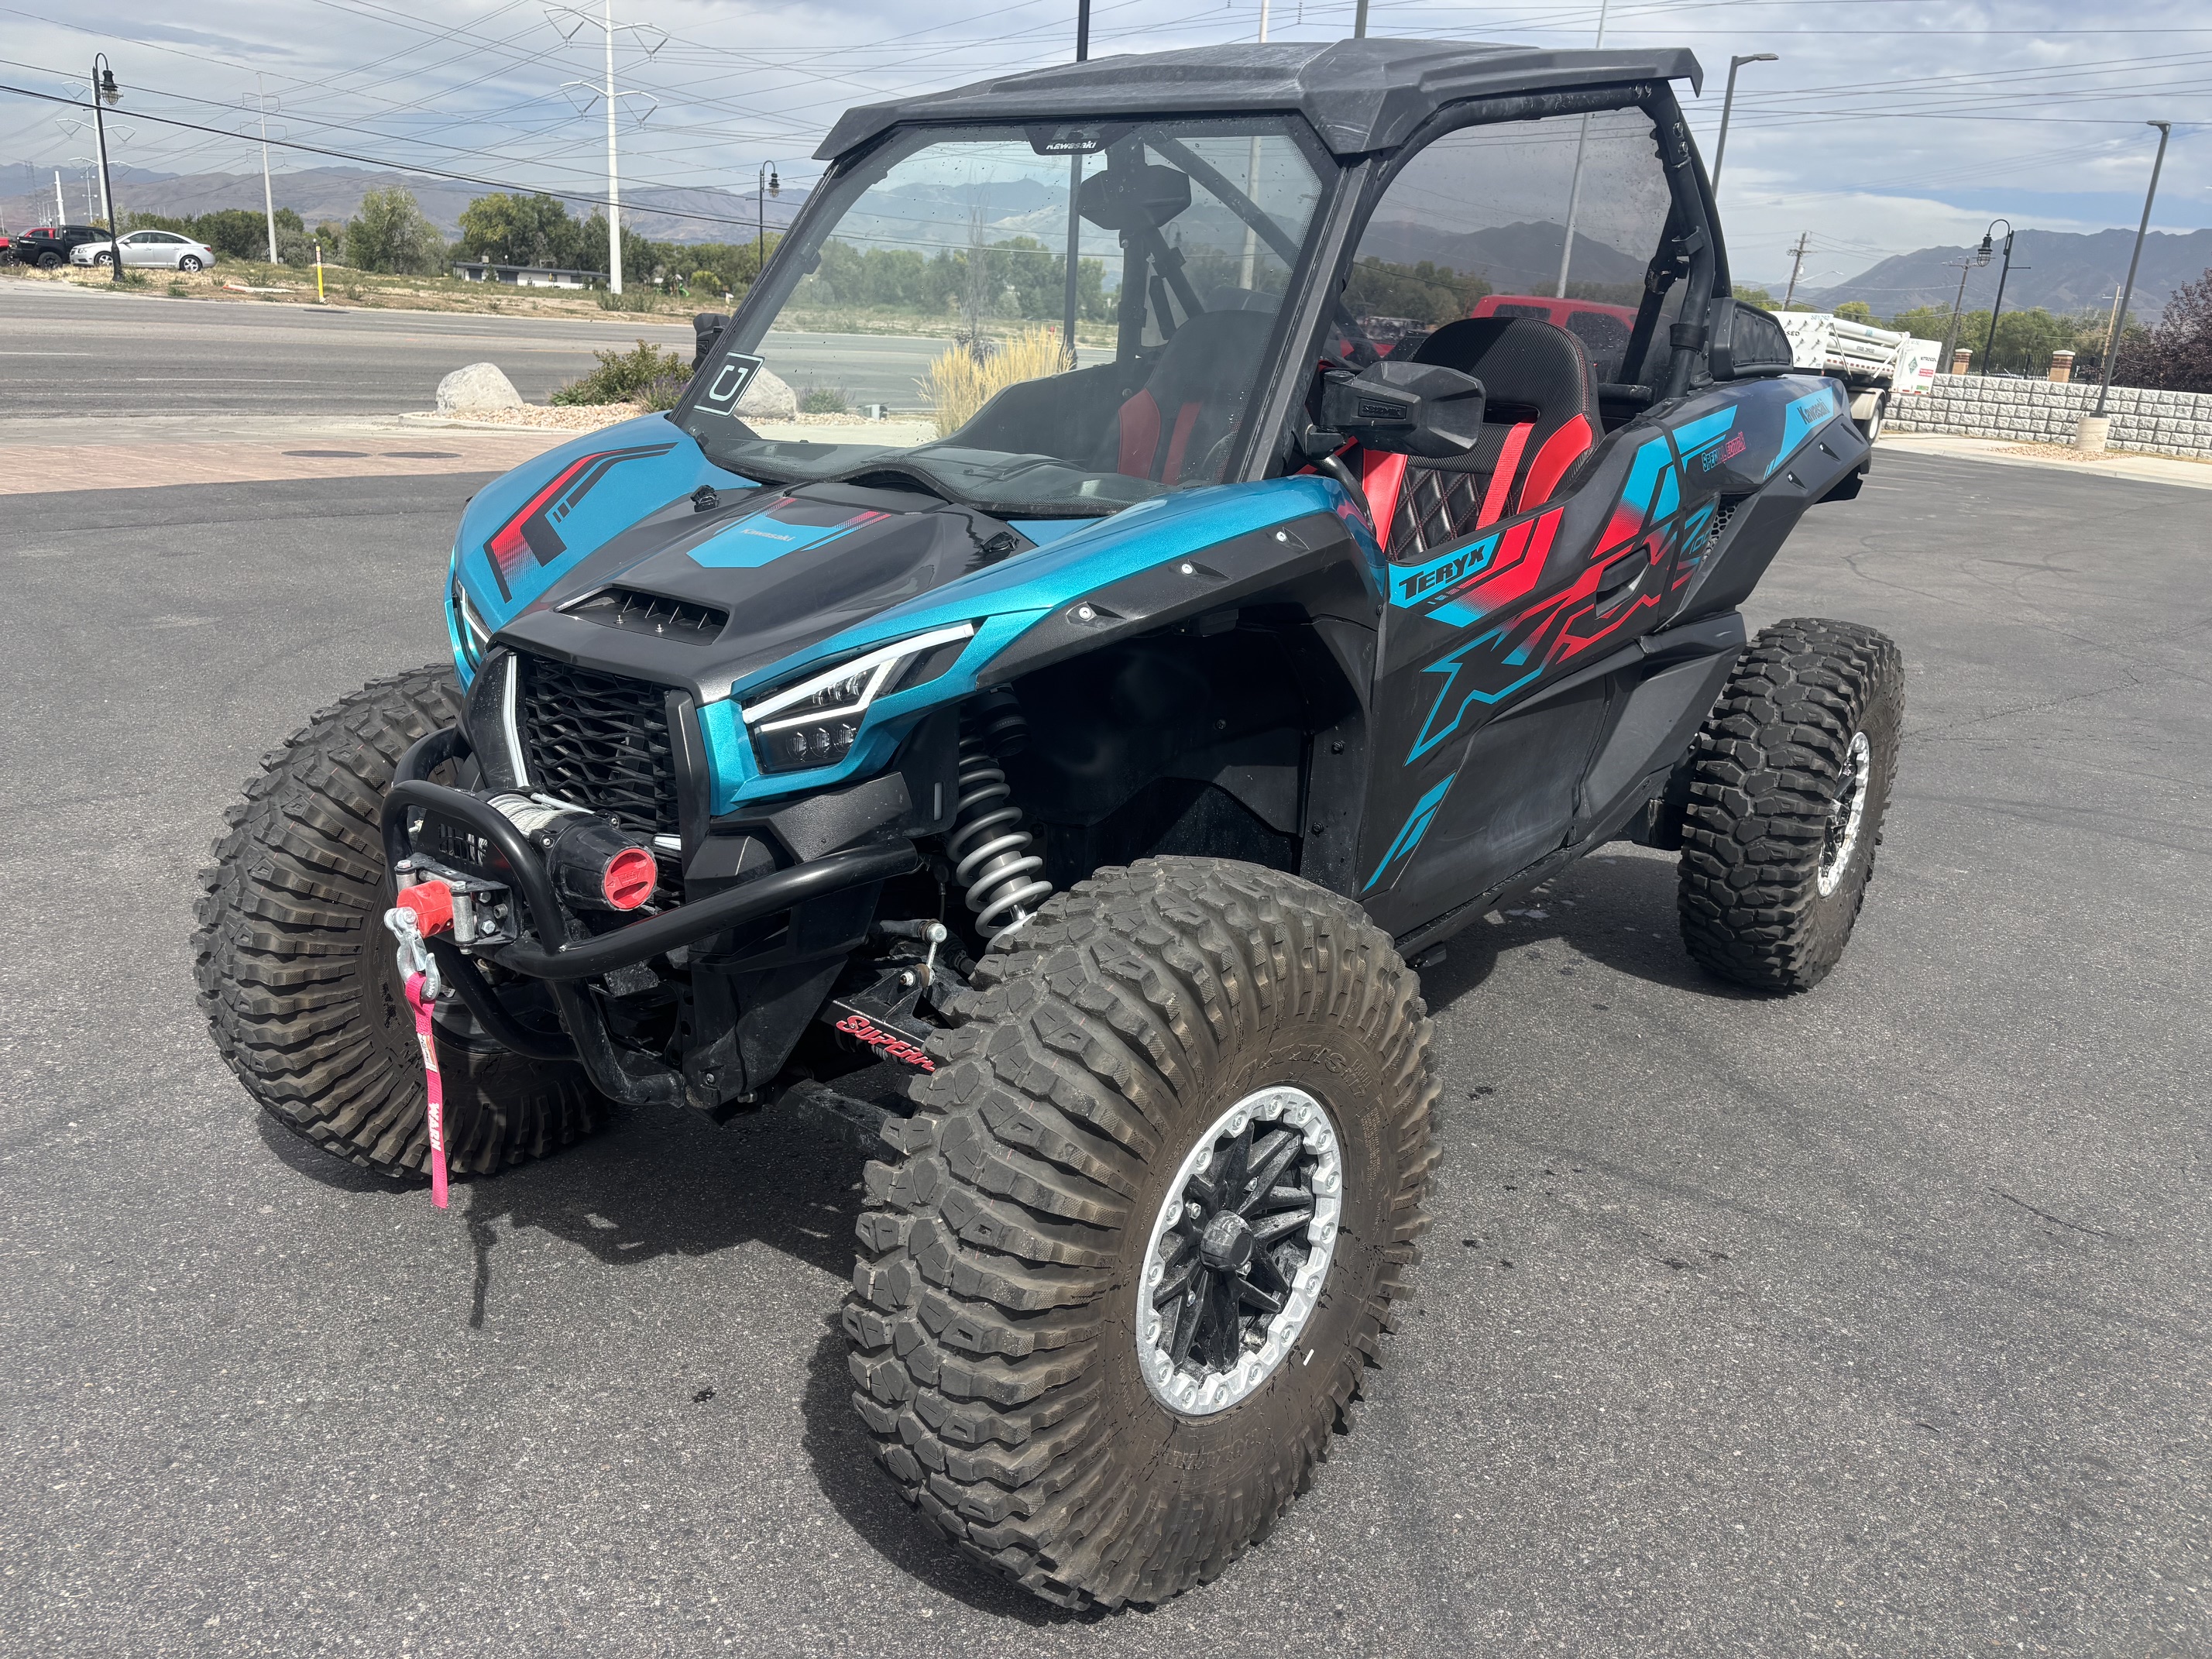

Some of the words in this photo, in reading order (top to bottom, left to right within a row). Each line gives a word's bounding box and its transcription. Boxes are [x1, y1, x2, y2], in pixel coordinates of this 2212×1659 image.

[1046, 140, 1097, 150] Kawasaki
[1797, 398, 1830, 425] Kawasaki
[740, 528, 796, 541] Kawasaki
[1398, 544, 1486, 600] TERYX
[428, 1102, 442, 1152] WARN
